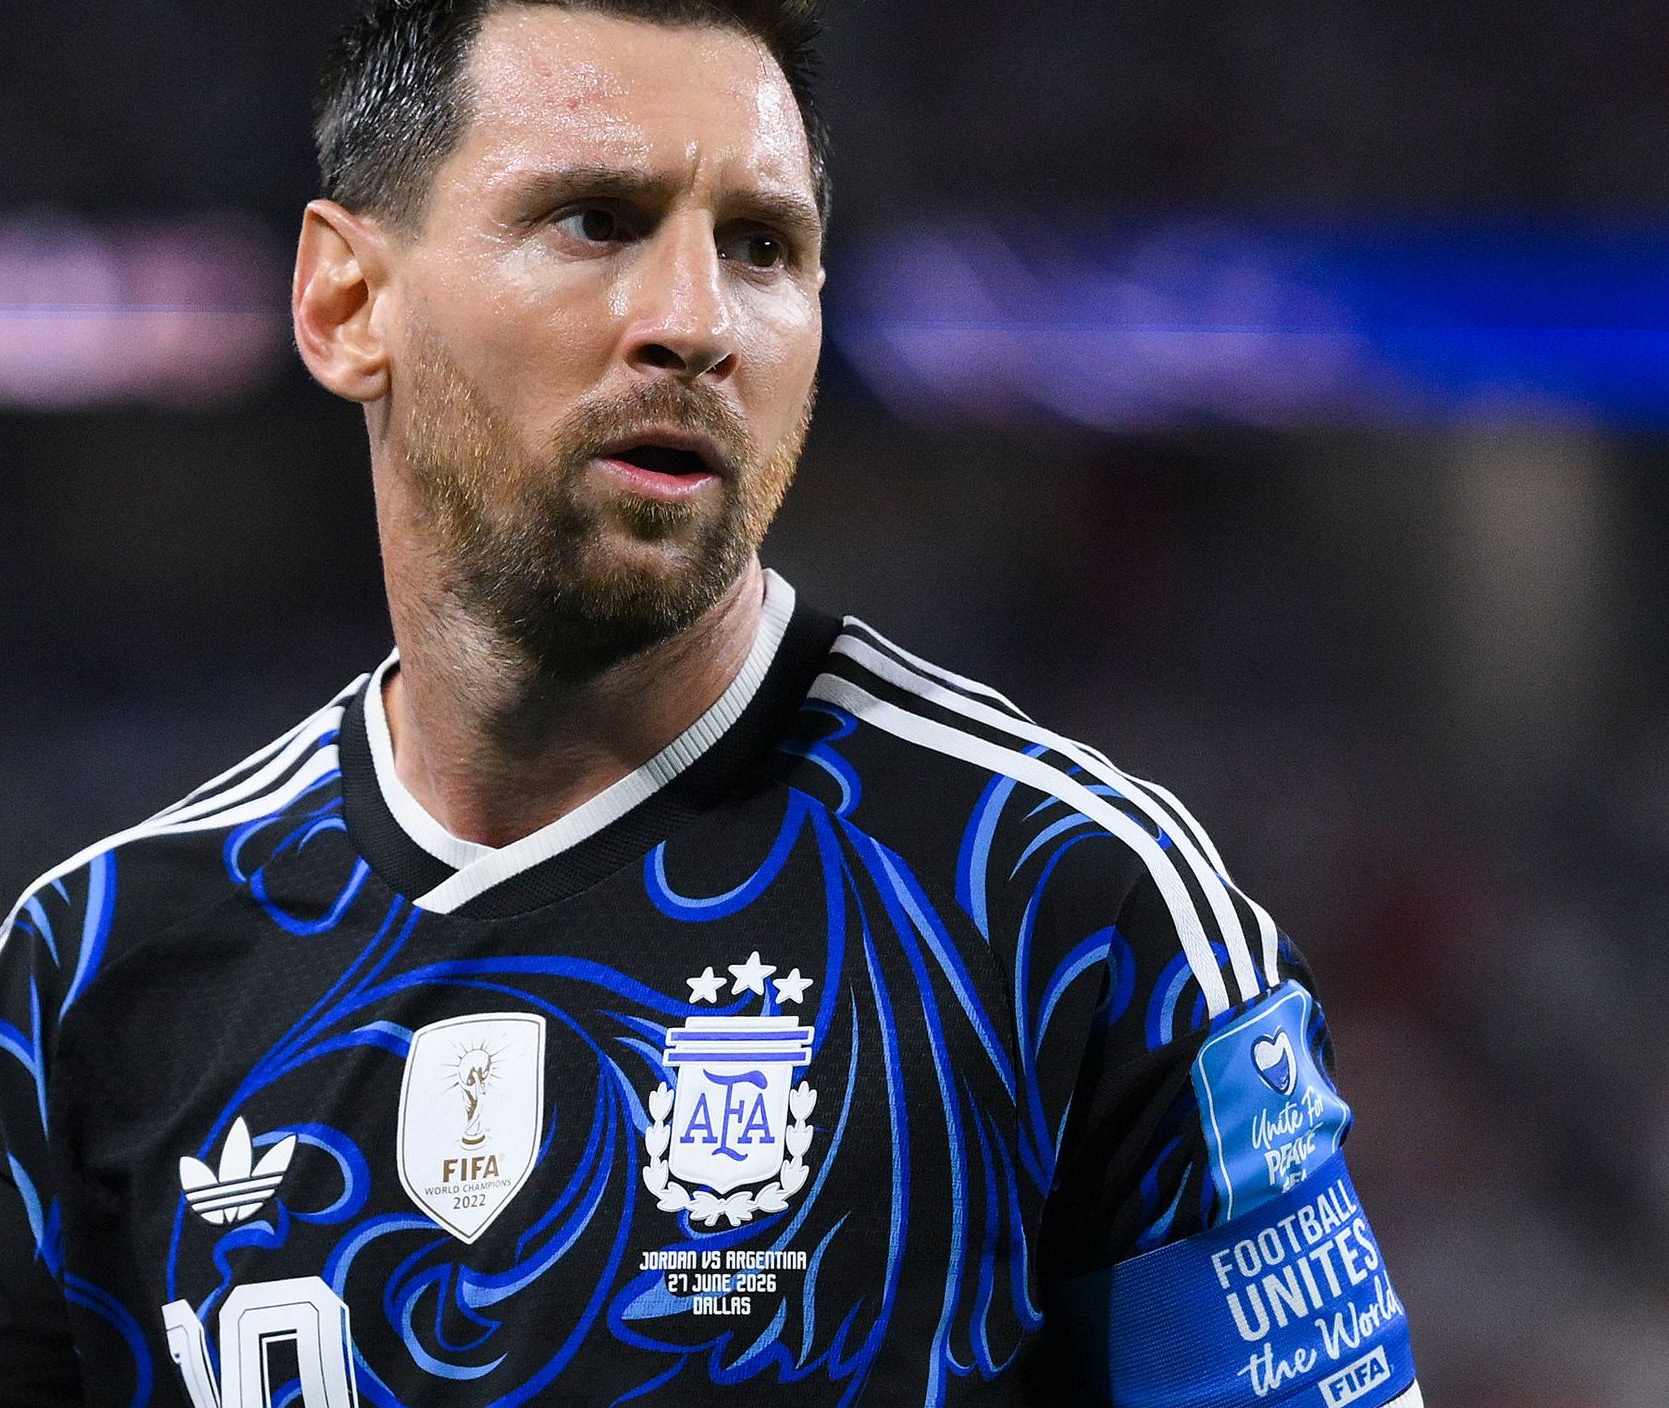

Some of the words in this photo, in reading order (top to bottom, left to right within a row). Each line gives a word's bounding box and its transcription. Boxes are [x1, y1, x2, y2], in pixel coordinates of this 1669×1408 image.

[679, 1068, 776, 1162] AFA
[1252, 1101, 1304, 1150] Unite
[424, 1185, 460, 1196] WORLD
[462, 1178, 512, 1194] CHAMPIONS
[442, 1154, 499, 1183] FIFA
[453, 1193, 486, 1210] 2022
[1211, 1179, 1358, 1290] FOOTBALL
[639, 1250, 697, 1271] JORDAN
[701, 1251, 721, 1270] VS
[725, 1250, 807, 1270] ARGENTINA
[1226, 1217, 1379, 1342] UNITES
[667, 1273, 688, 1293] 27
[691, 1273, 732, 1293] JUNE
[736, 1273, 777, 1293] 2026
[692, 1296, 751, 1316] DALLAS
[1236, 1341, 1317, 1398] the
[1314, 1269, 1404, 1360] World
[1327, 1356, 1386, 1403] FIFA
